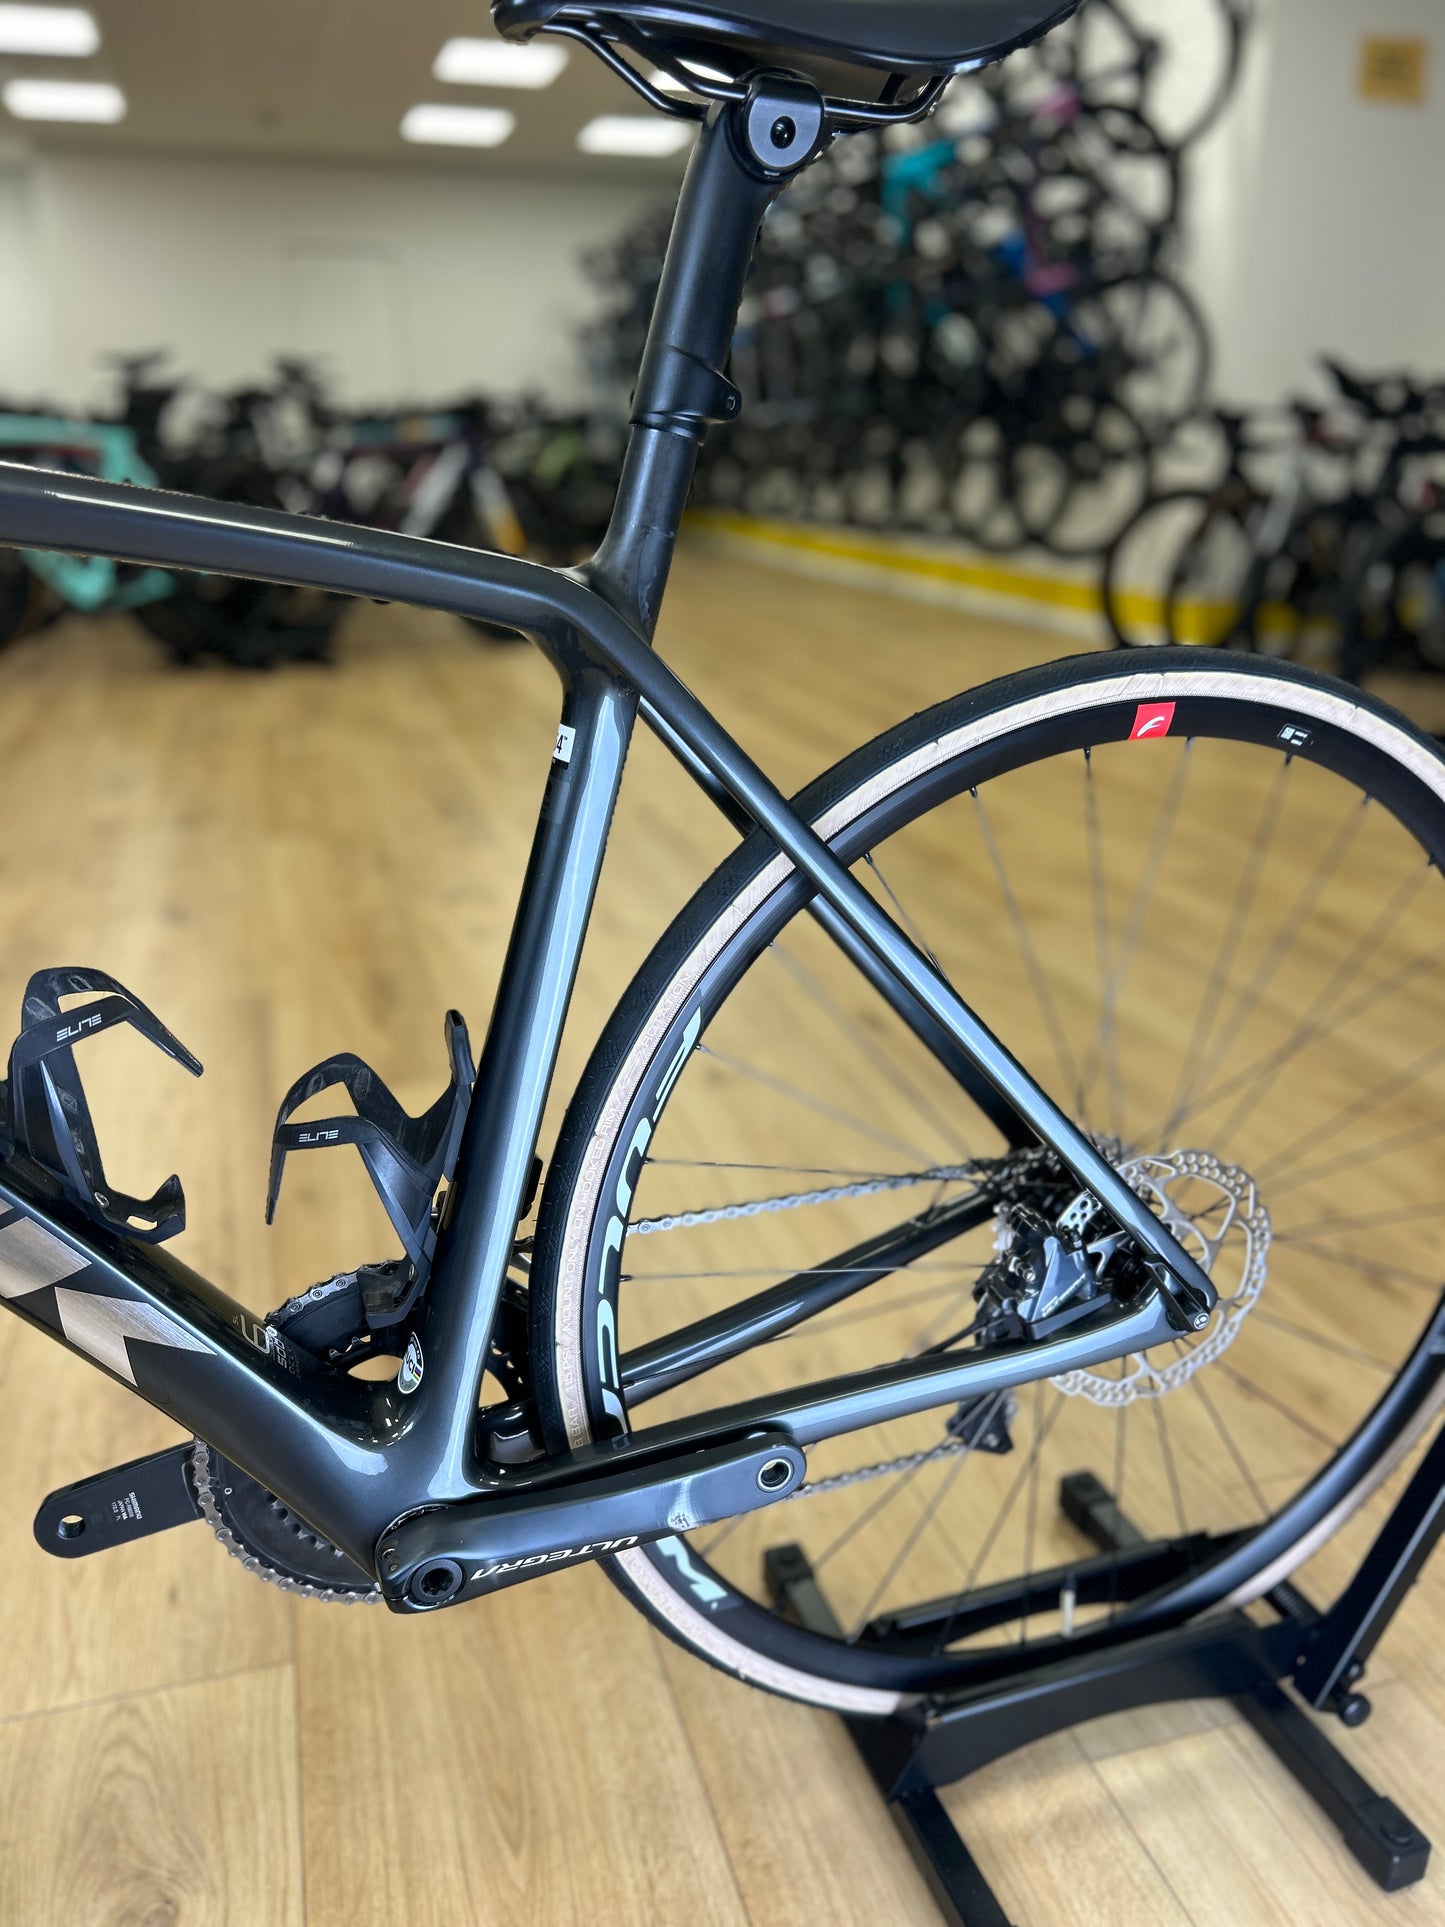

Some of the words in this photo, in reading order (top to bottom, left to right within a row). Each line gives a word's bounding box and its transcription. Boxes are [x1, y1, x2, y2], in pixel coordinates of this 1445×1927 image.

[643, 972, 691, 1049] ROTATION
[56, 1013, 102, 1041] ELITE
[298, 1129, 339, 1143] ELITE
[600, 1107, 619, 1135] RIM
[579, 1138, 606, 1203] HOOKED
[574, 1206, 587, 1229] ON
[566, 1234, 580, 1274] ONLY
[562, 1278, 575, 1332] MOUNT
[240, 1313, 271, 1355] 6
[562, 1373, 574, 1392] 115
[568, 1407, 581, 1438] BAR
[129, 1491, 143, 1519] SHIMANO
[470, 1535, 639, 1581] ULTEGRA
